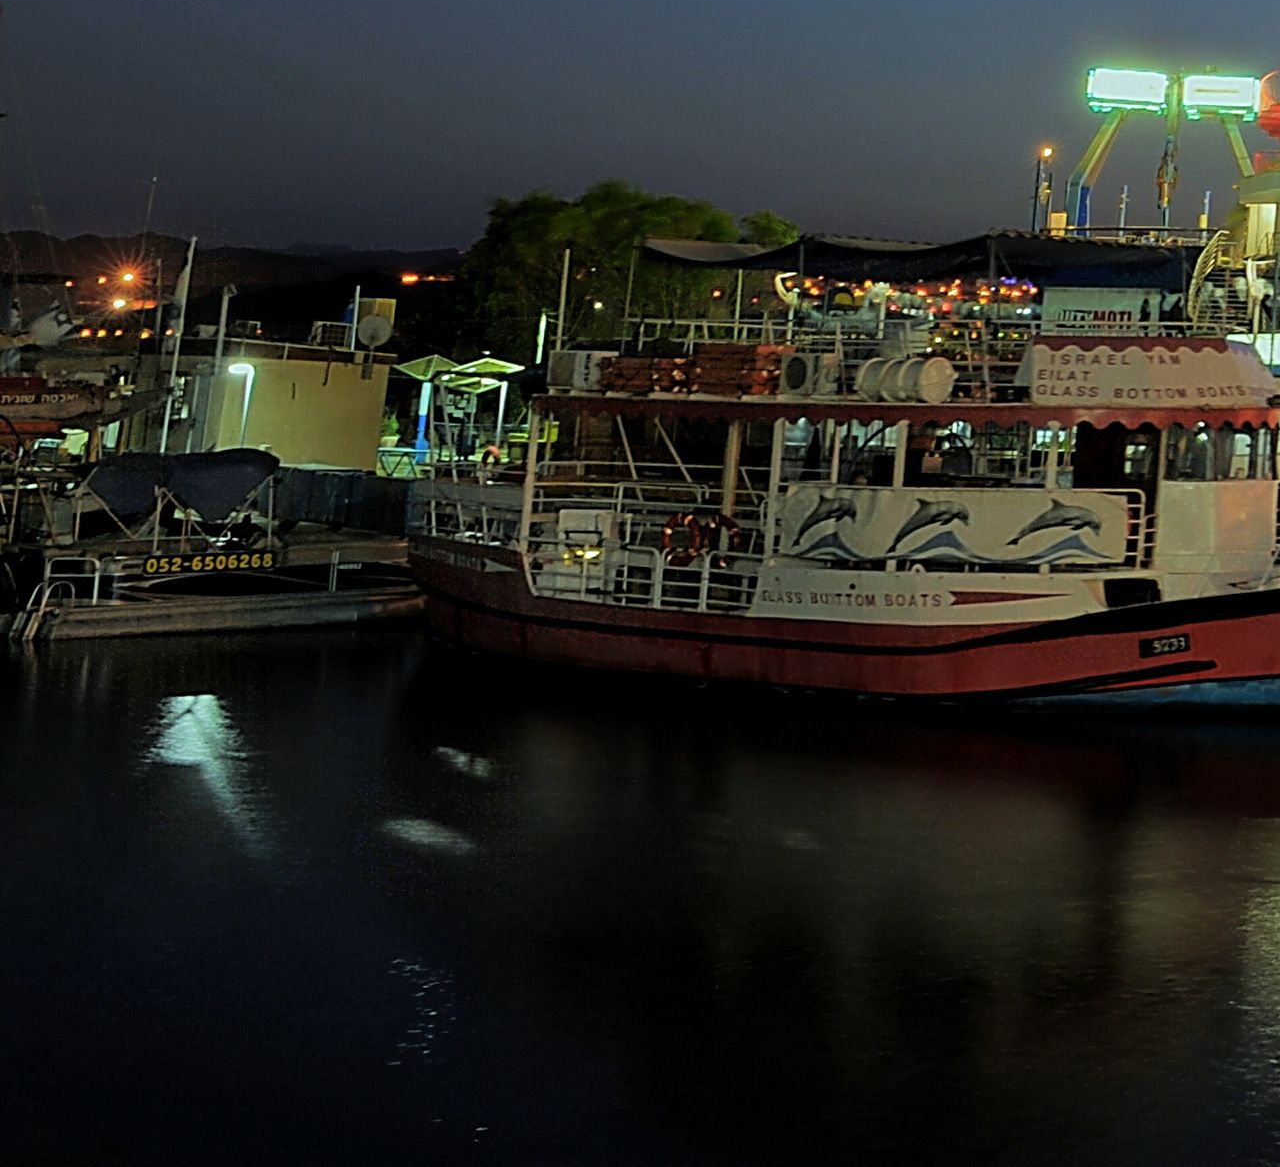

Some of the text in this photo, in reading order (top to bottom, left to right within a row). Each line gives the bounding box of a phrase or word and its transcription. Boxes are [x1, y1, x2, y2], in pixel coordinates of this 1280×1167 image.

[1051, 354, 1182, 365] ISRAEL YAM
[1036, 369, 1091, 381] EILAT
[1036, 384, 1246, 399] GLASS BOTTOM BOATS
[146, 553, 273, 573] 052-6506268
[884, 593, 942, 607] BOATS
